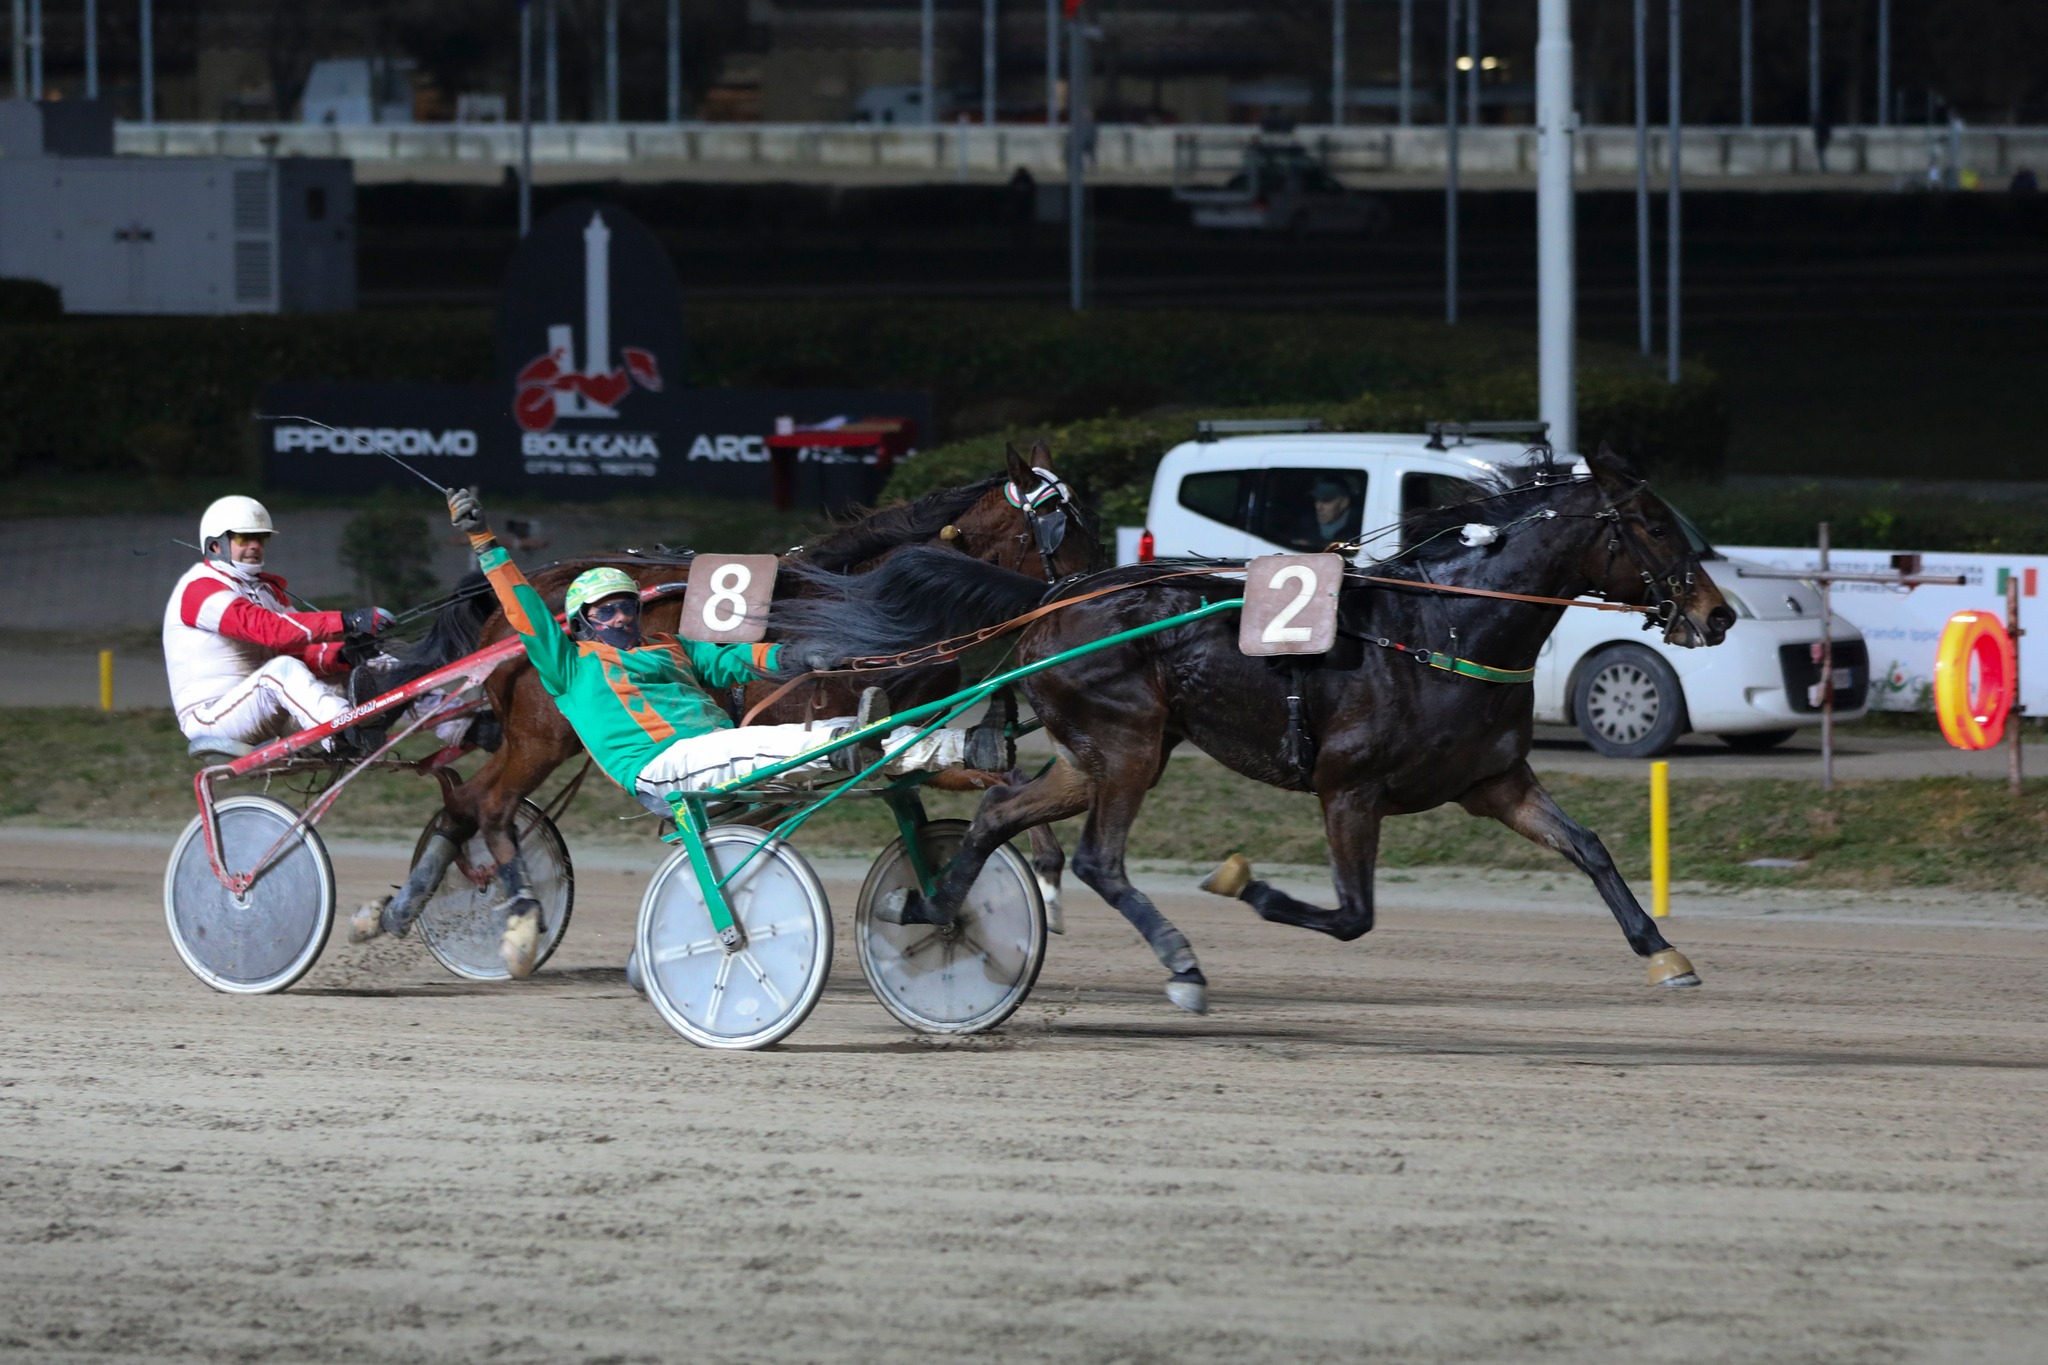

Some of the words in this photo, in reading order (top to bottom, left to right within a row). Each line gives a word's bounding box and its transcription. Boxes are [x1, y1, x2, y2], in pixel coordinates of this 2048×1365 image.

[273, 426, 478, 457] IPPODROMO
[521, 432, 660, 458] BOLOGNA
[702, 563, 752, 632] 8
[1261, 565, 1318, 643] 2
[331, 700, 377, 729] CUSTOM
